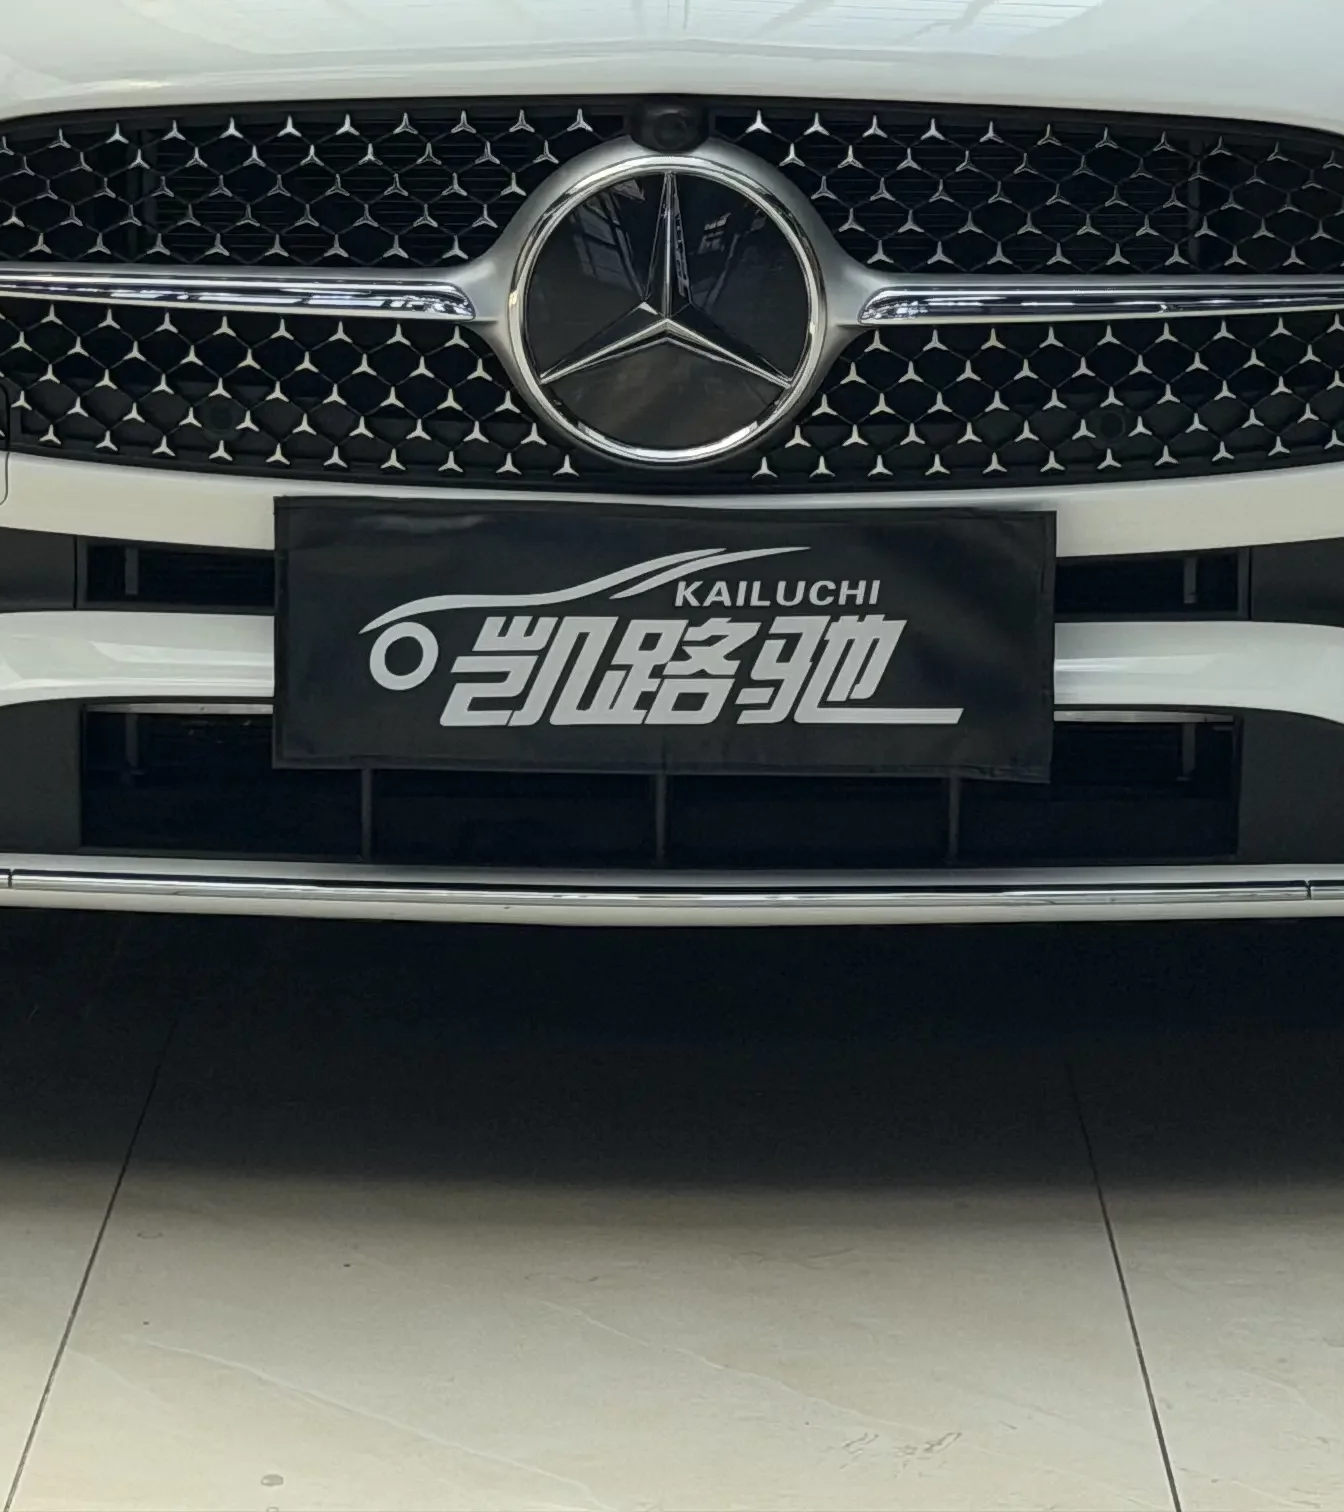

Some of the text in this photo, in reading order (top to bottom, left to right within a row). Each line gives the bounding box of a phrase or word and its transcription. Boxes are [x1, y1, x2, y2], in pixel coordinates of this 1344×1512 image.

[674, 579, 881, 607] KAILUCHI
[439, 614, 965, 728] 凯路驰
